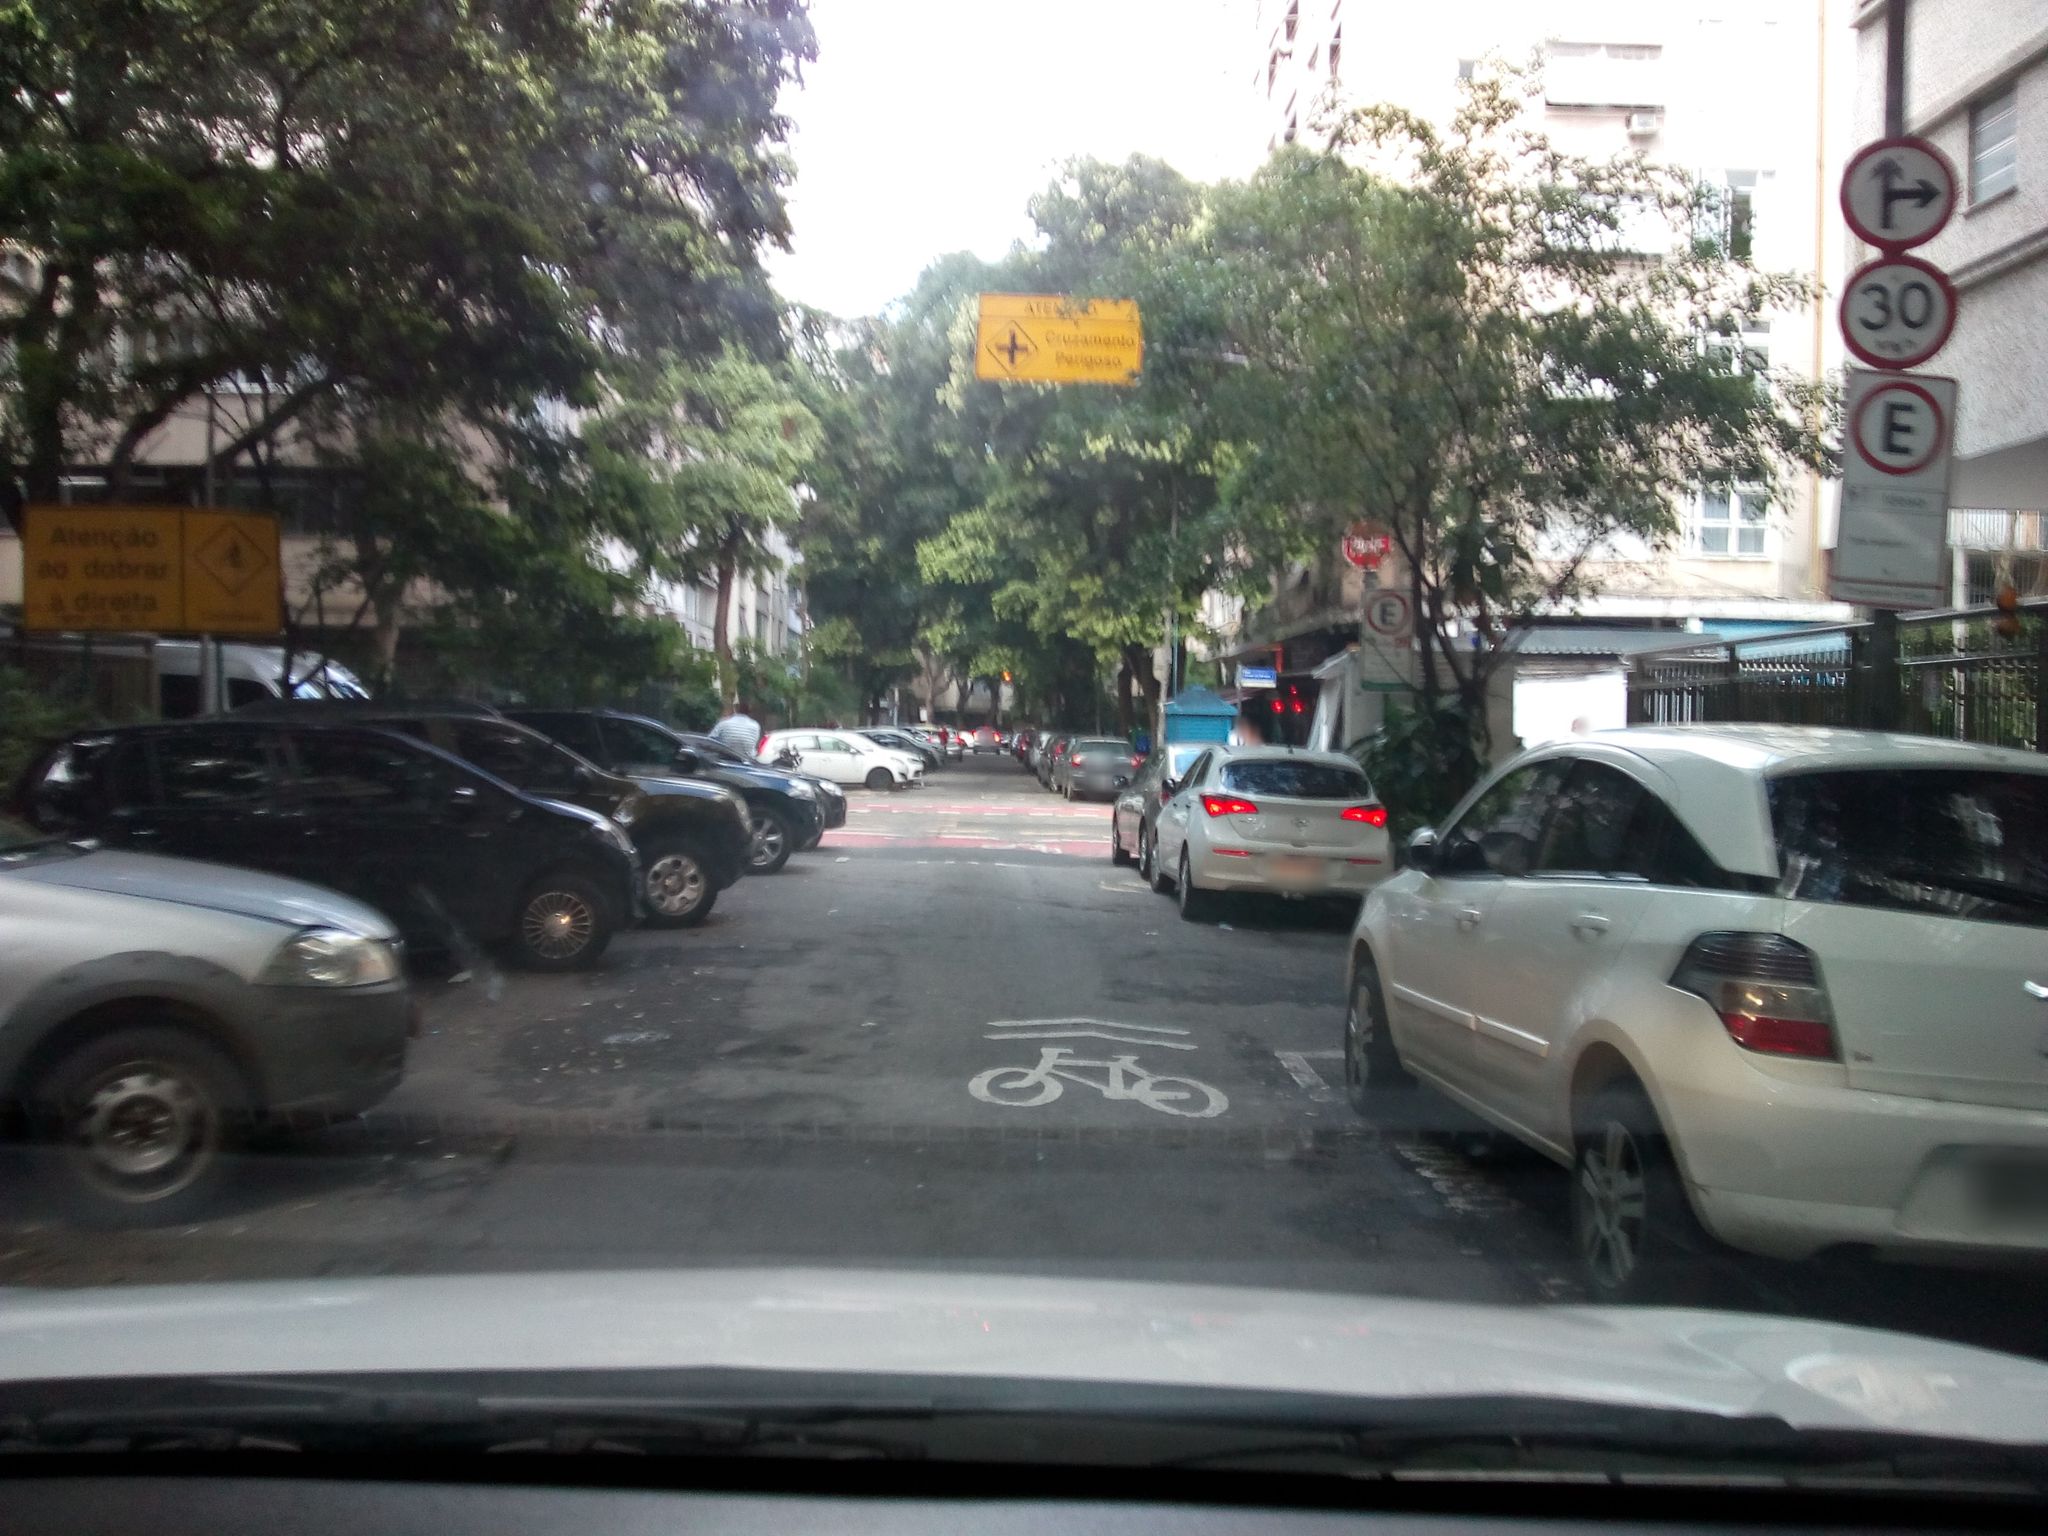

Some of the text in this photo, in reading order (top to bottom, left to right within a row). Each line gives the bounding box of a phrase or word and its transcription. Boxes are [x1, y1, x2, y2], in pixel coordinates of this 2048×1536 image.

[1859, 281, 1932, 330] 30
[1045, 329, 1135, 347] Cruzamento
[1055, 351, 1122, 370] Perigoso
[1883, 402, 1916, 456] E
[51, 525, 159, 552] Atenção
[38, 558, 168, 579] ao dobrar
[74, 590, 159, 612] direita
[1379, 602, 1397, 626] E
